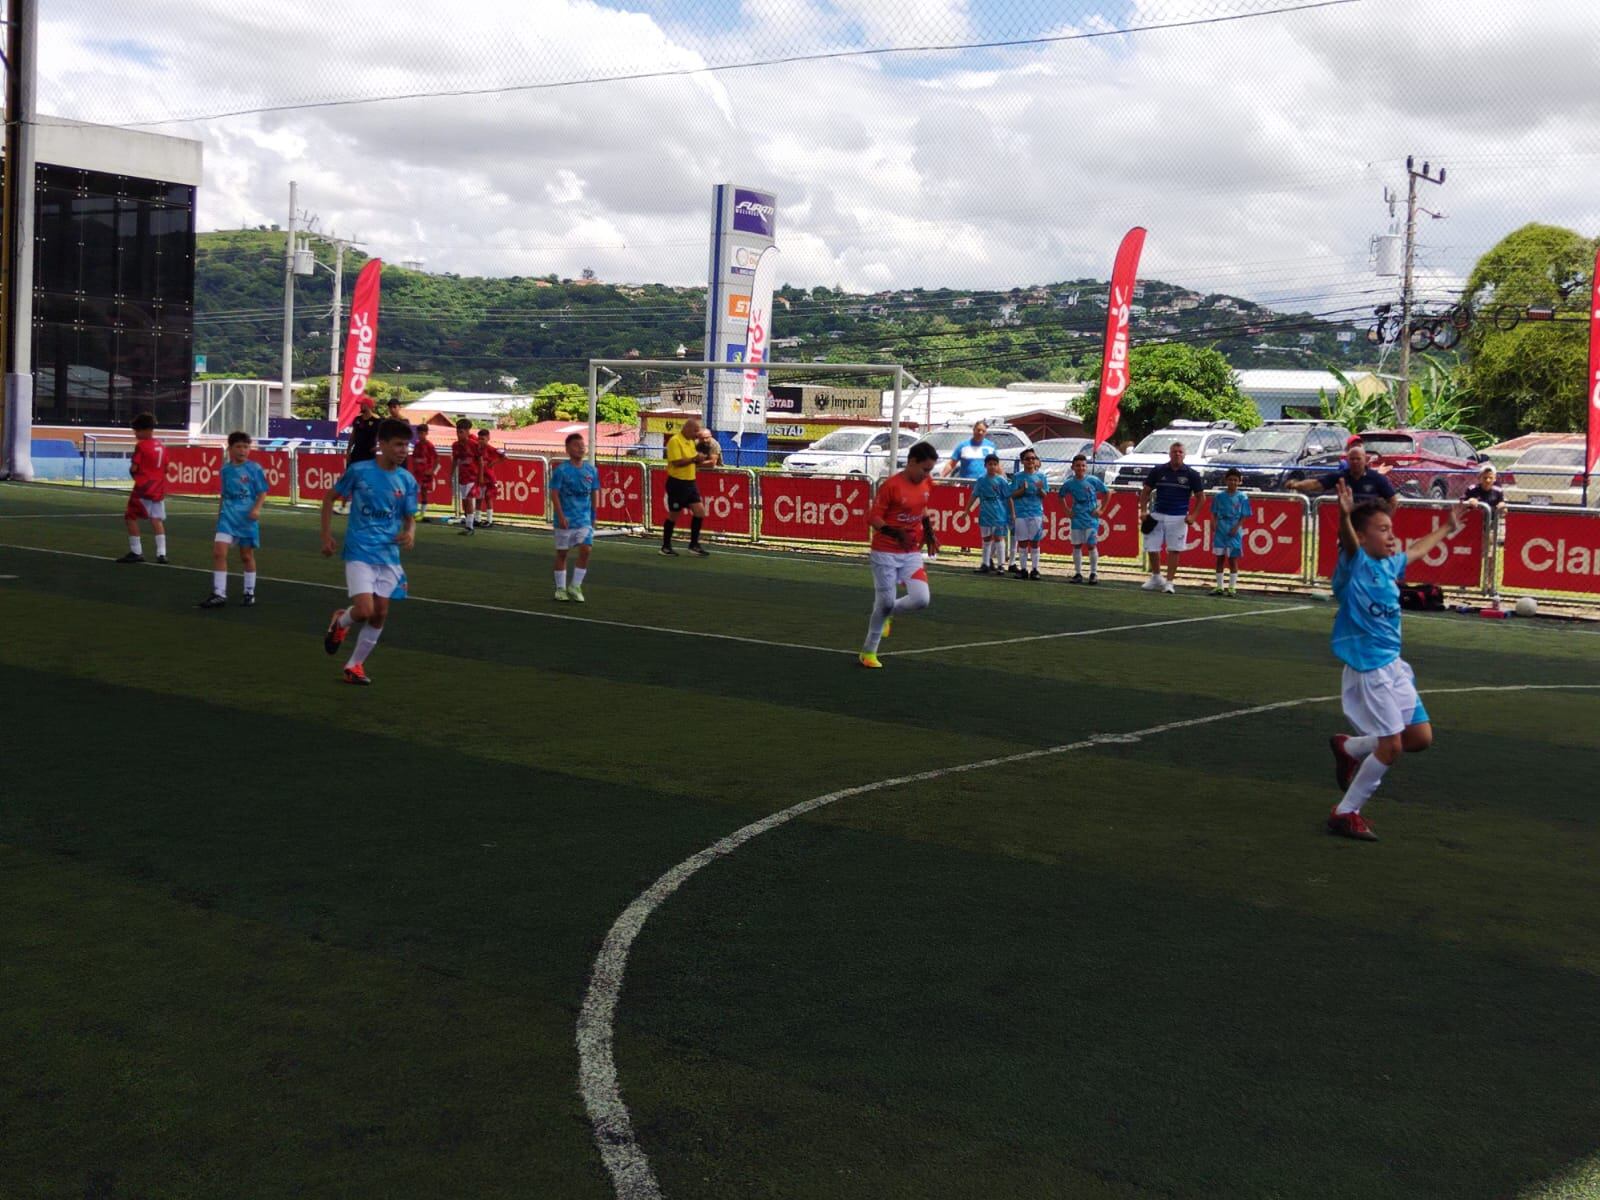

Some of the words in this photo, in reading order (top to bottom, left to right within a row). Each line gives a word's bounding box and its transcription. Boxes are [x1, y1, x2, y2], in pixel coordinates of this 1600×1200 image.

[350, 325, 373, 396] Claro
[1105, 303, 1129, 396] Claro
[767, 399, 794, 408] STAD
[831, 395, 867, 411] Imperial
[766, 424, 805, 436] ISTAD
[165, 462, 211, 484] Claro
[305, 468, 342, 490] Clar
[496, 480, 529, 502] aro
[774, 495, 849, 526] Claro
[927, 508, 972, 533] aro
